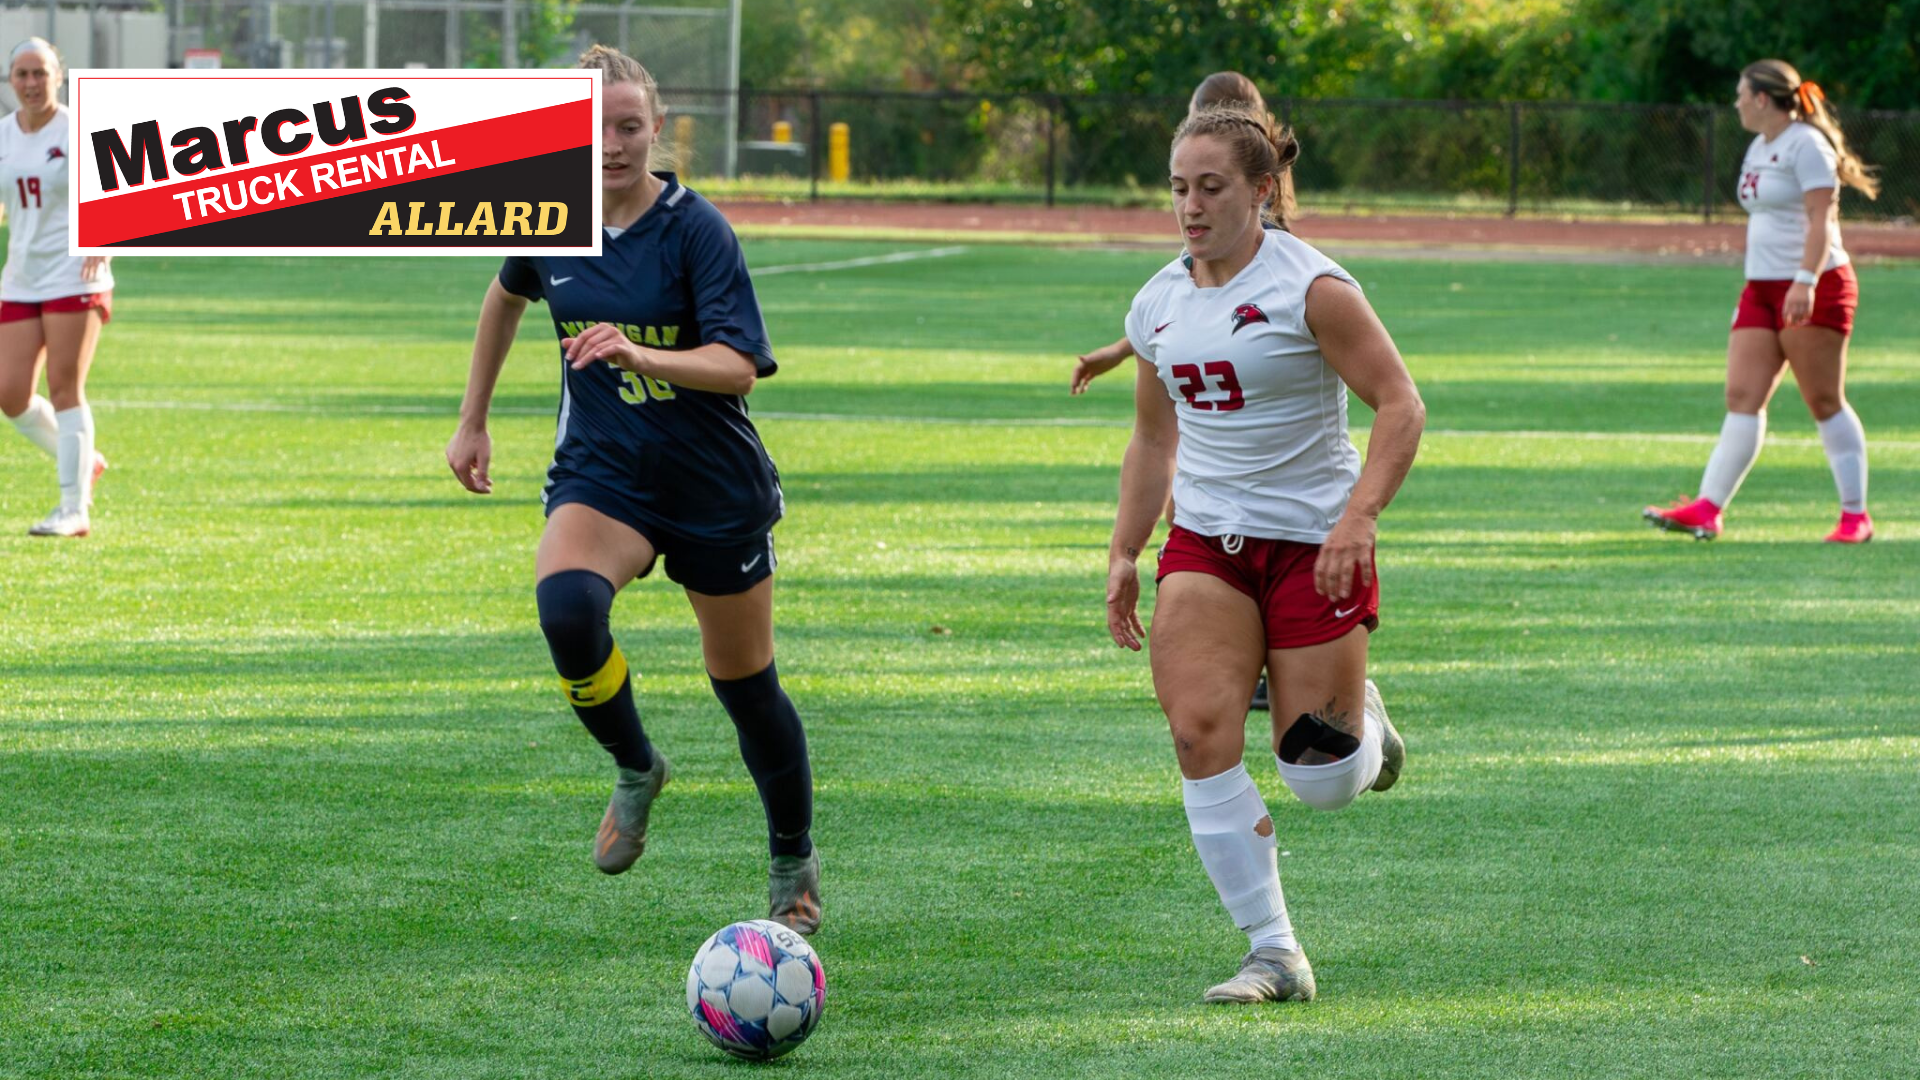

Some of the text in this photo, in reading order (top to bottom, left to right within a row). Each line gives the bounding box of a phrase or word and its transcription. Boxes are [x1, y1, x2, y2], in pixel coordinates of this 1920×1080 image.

[17, 177, 41, 208] 19
[560, 321, 679, 346] MGAN
[1171, 360, 1245, 411] 23
